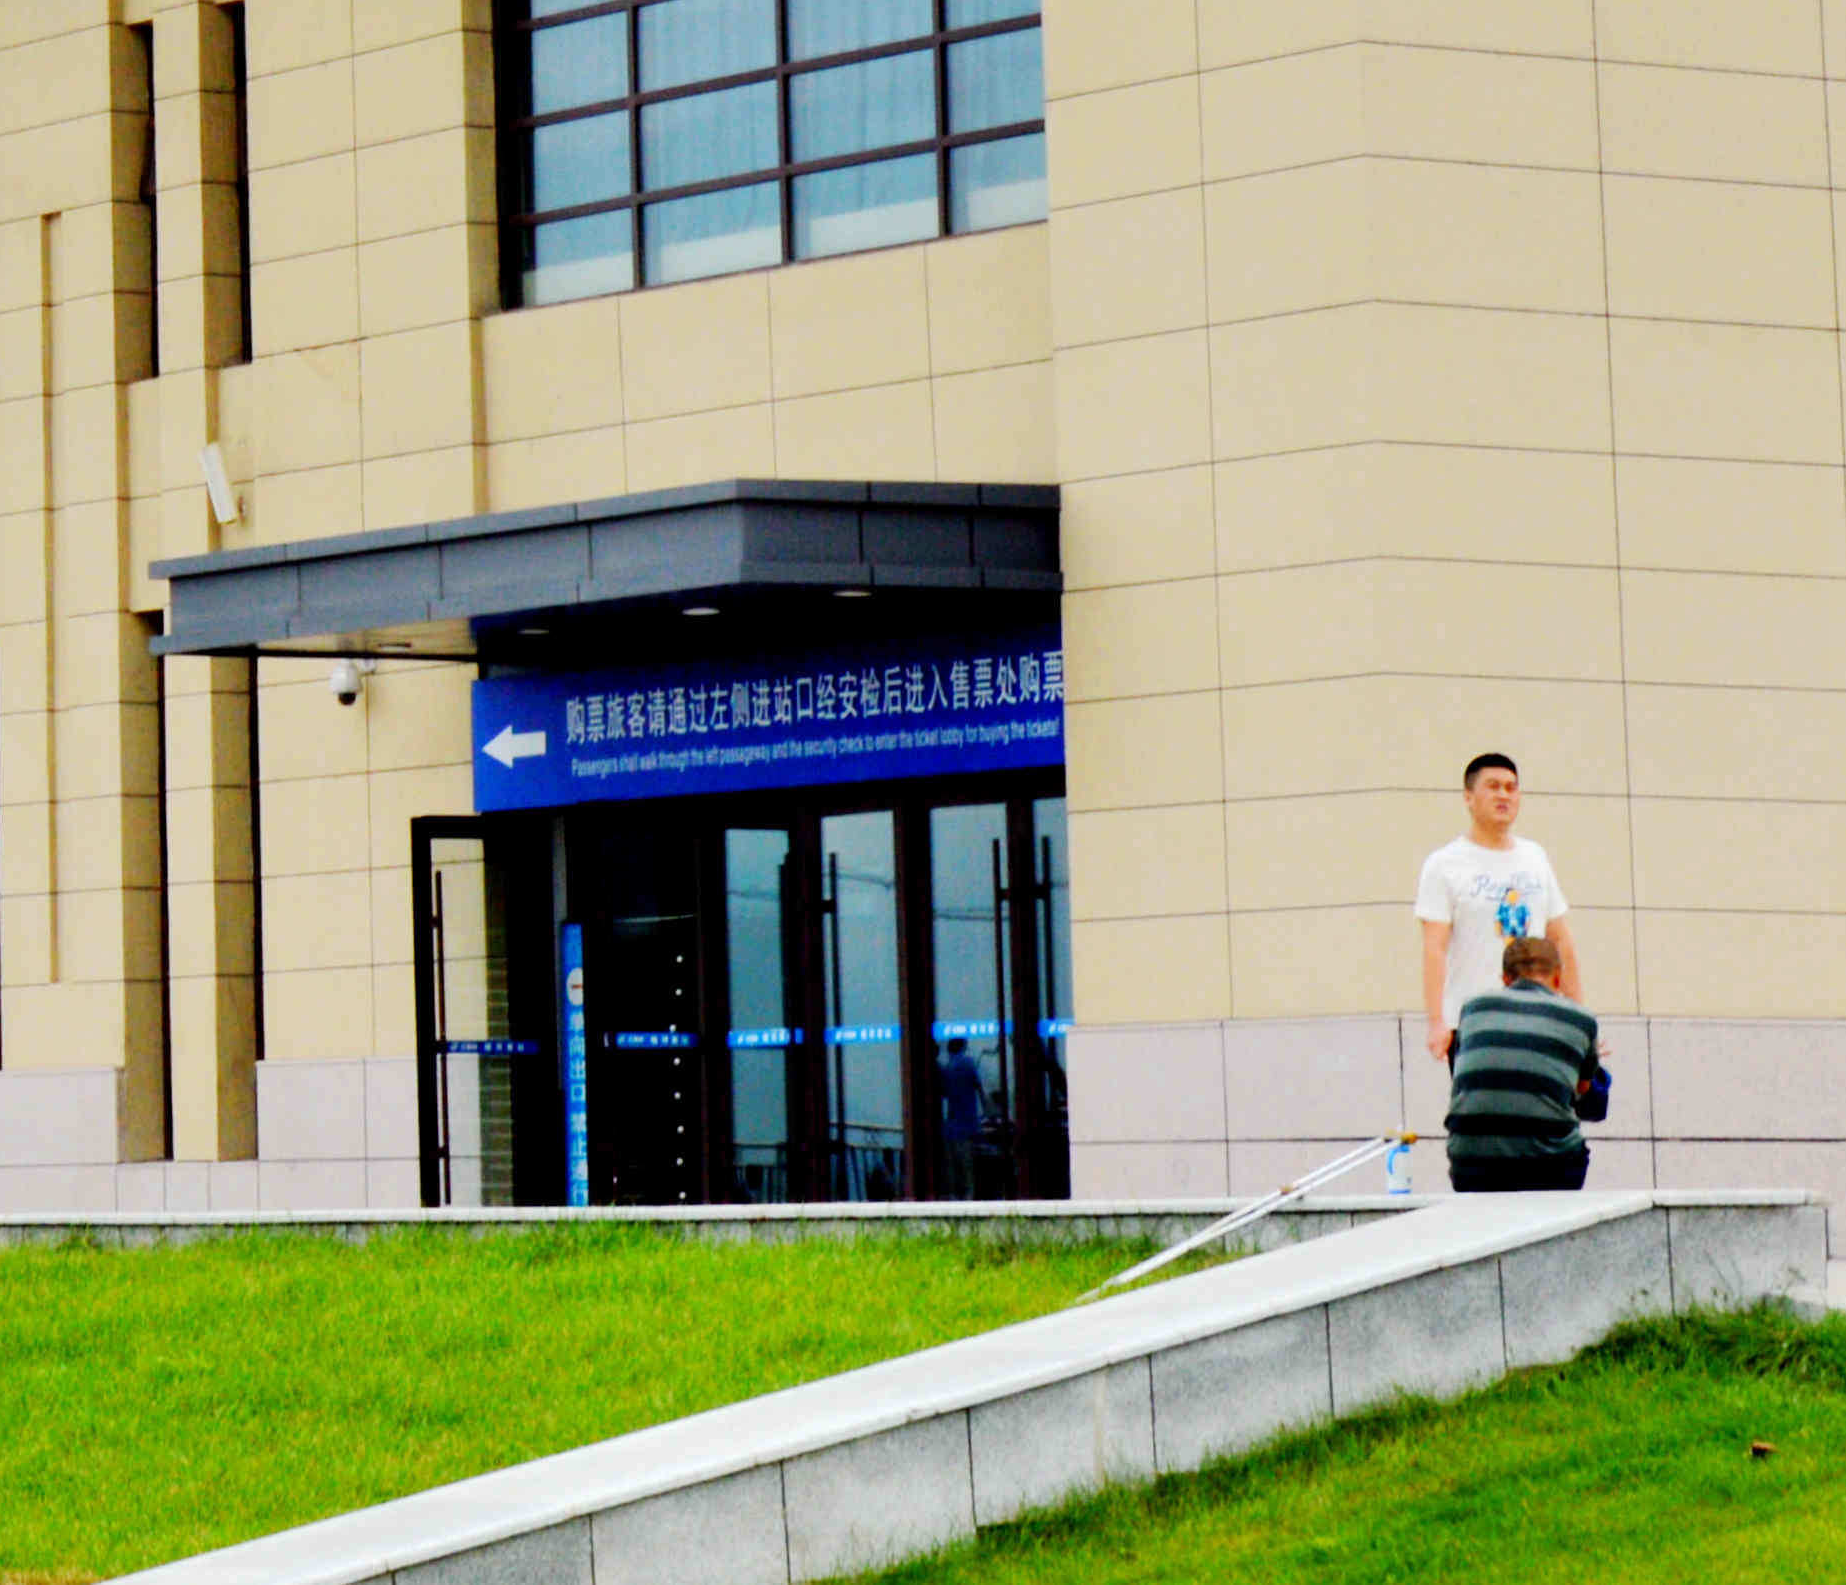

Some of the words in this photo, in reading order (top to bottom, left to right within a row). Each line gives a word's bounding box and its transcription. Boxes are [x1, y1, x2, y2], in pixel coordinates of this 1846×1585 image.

[566, 649, 1063, 745] 购票旅客请通过左侧进站口经安检后进入售票处购票
